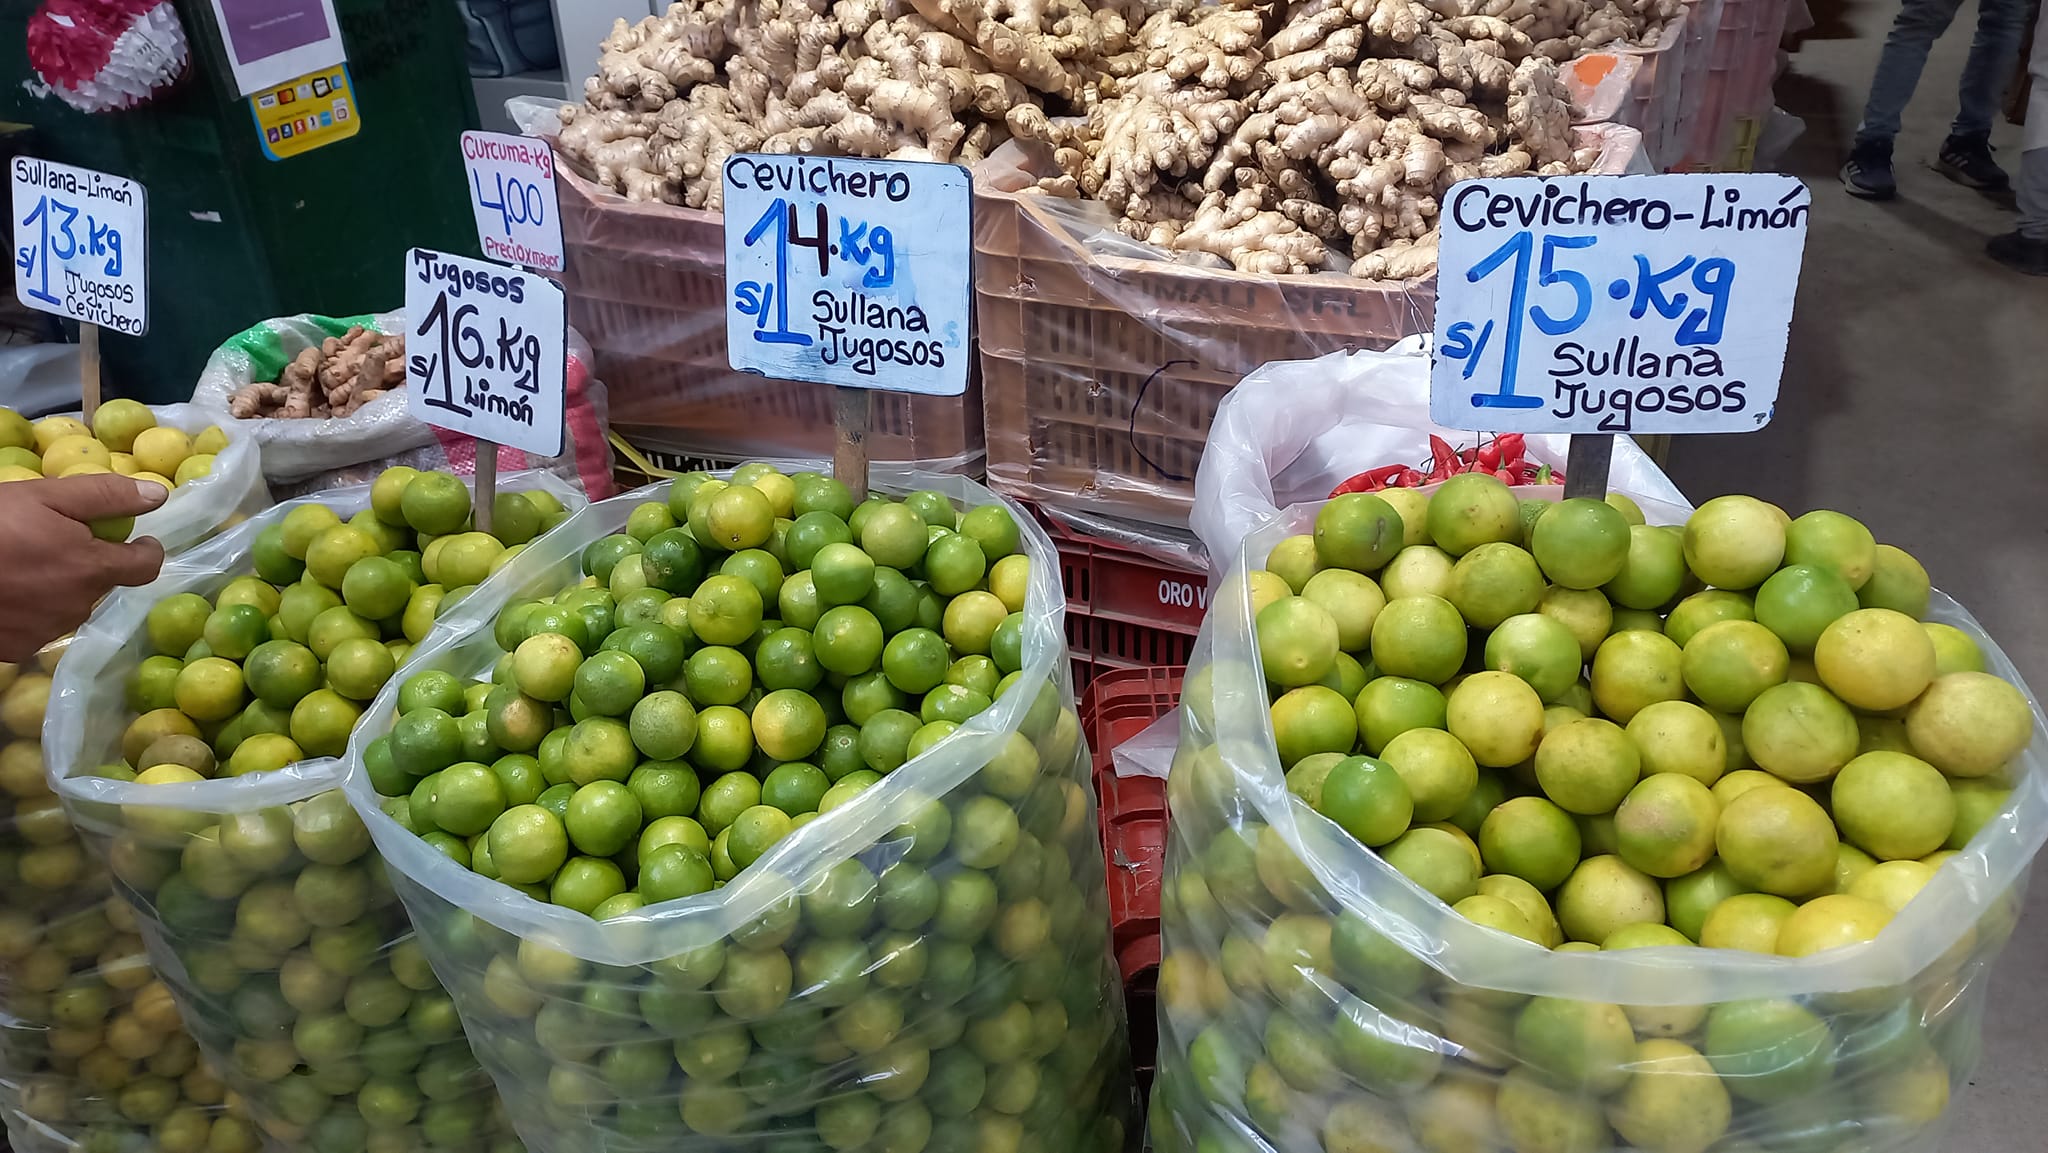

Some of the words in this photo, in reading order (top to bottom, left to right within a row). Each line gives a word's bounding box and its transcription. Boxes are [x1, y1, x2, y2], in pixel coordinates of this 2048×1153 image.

[16, 160, 132, 206] Sullana-Limón
[727, 157, 910, 201] Cevichero
[1453, 182, 1810, 233] Cevichero-Limón
[65, 269, 134, 308] Jugosos
[414, 249, 525, 303] Jugosos
[65, 295, 142, 334] Cevichero
[812, 290, 930, 334] Sullana
[819, 324, 945, 375] Jugosos
[1548, 336, 1724, 378] Sullana
[464, 376, 534, 426] Limón
[1553, 381, 1747, 431] Jugosos
[1158, 579, 1193, 608] ORO
